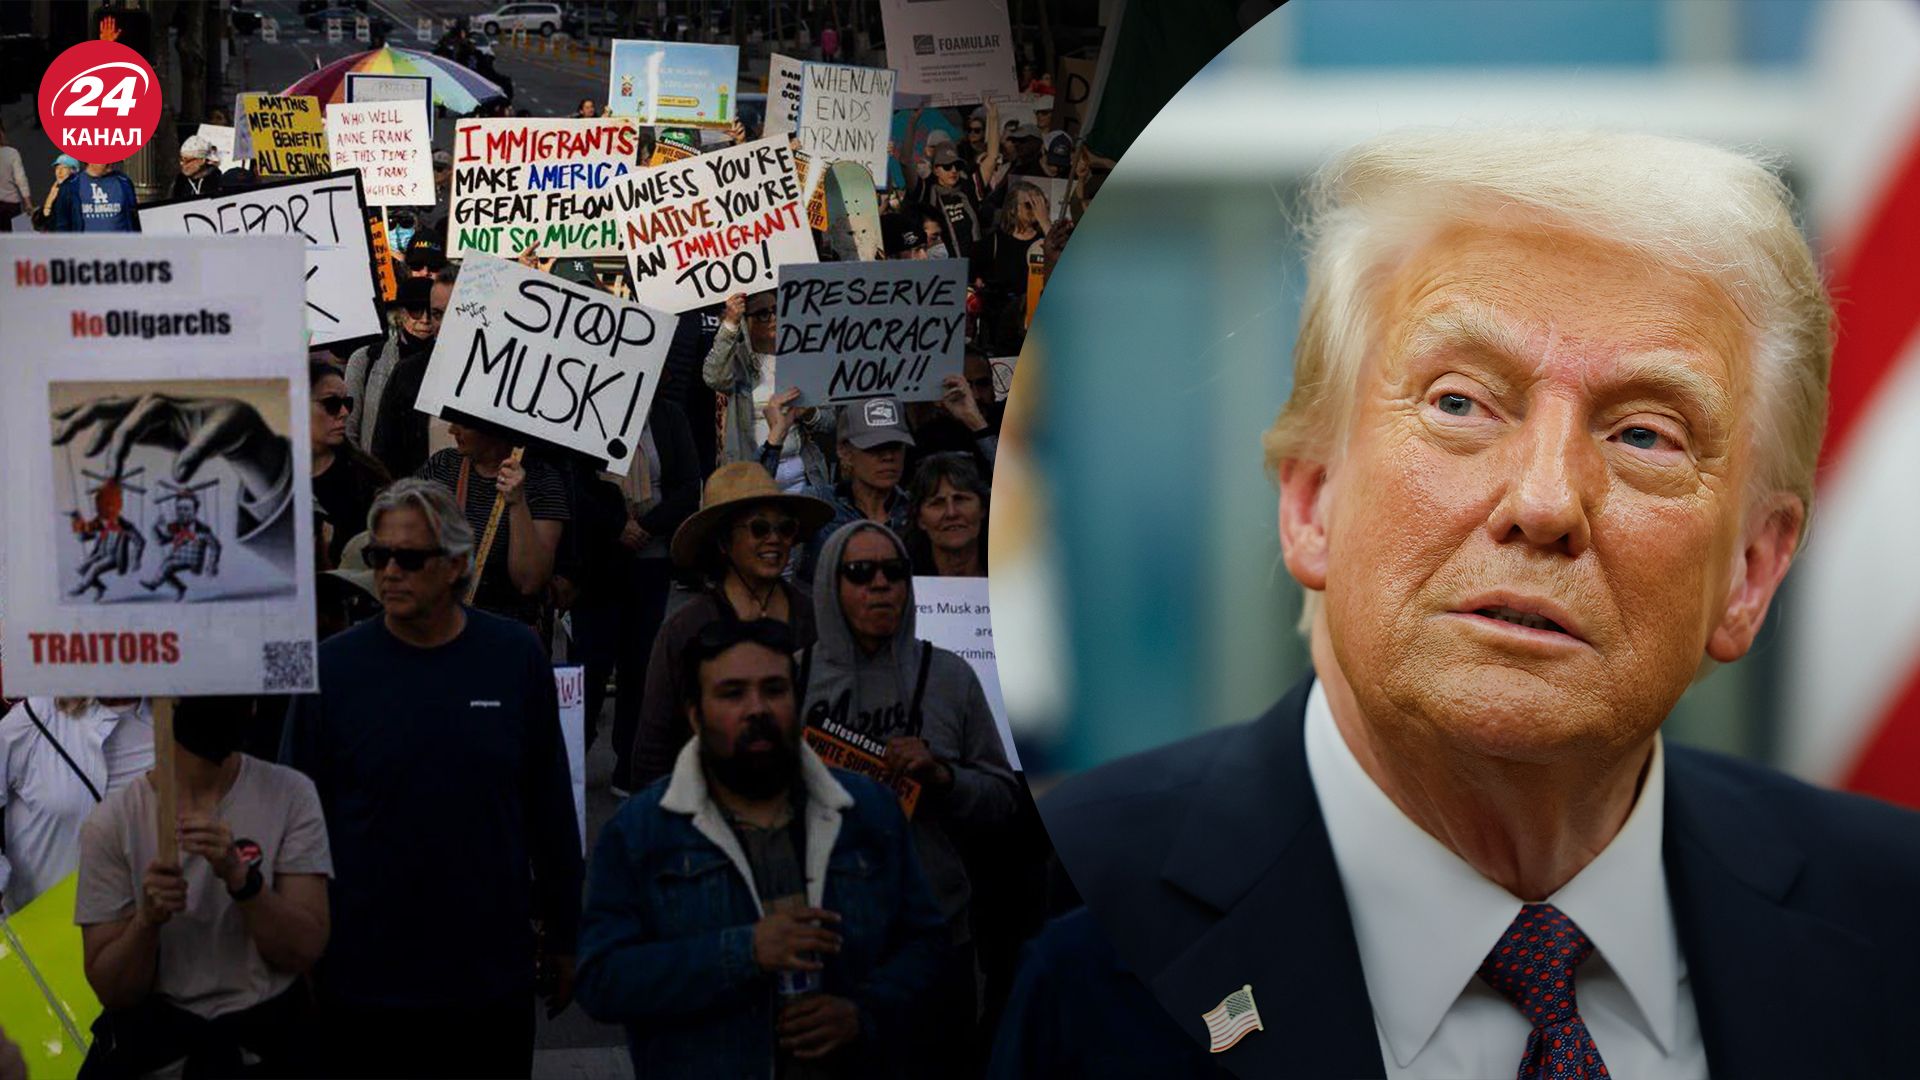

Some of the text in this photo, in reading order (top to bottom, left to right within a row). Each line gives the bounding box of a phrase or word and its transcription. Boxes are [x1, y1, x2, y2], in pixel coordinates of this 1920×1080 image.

[938, 34, 1000, 51] FOAMULAR
[258, 96, 309, 113] MAY THIS
[341, 109, 403, 125] WHO WILL
[817, 96, 872, 121] ENDS
[249, 112, 294, 132] MERIT
[272, 130, 323, 149] BENEFIT
[337, 128, 413, 147] ANNE FRANK
[458, 124, 637, 165] IMMIGRANTS
[799, 126, 881, 153] TYRANNY
[258, 149, 332, 177] ALL BEINGS
[336, 151, 350, 165] BE
[353, 149, 377, 163] THIS
[377, 166, 408, 178] TRANS
[456, 162, 629, 197] MAKE AMERICA
[615, 168, 700, 212] UNLESS
[706, 146, 793, 189] YOU'RE
[90, 183, 109, 204] LA
[546, 193, 614, 222] FELON
[626, 175, 799, 250] NATIVE, YOU'RE
[458, 227, 504, 254] NOT
[509, 227, 540, 254] SO
[636, 200, 801, 282] AN IMMIGRANT
[675, 240, 774, 299] TOO!
[780, 275, 957, 318] PRESERVE
[503, 279, 656, 358] STOP
[776, 313, 966, 356] DEMOCRACY
[828, 355, 931, 397] NOW!!
[455, 328, 646, 460] MUSK!
[936, 602, 972, 614] Musk
[29, 631, 181, 666] TRAITORS
